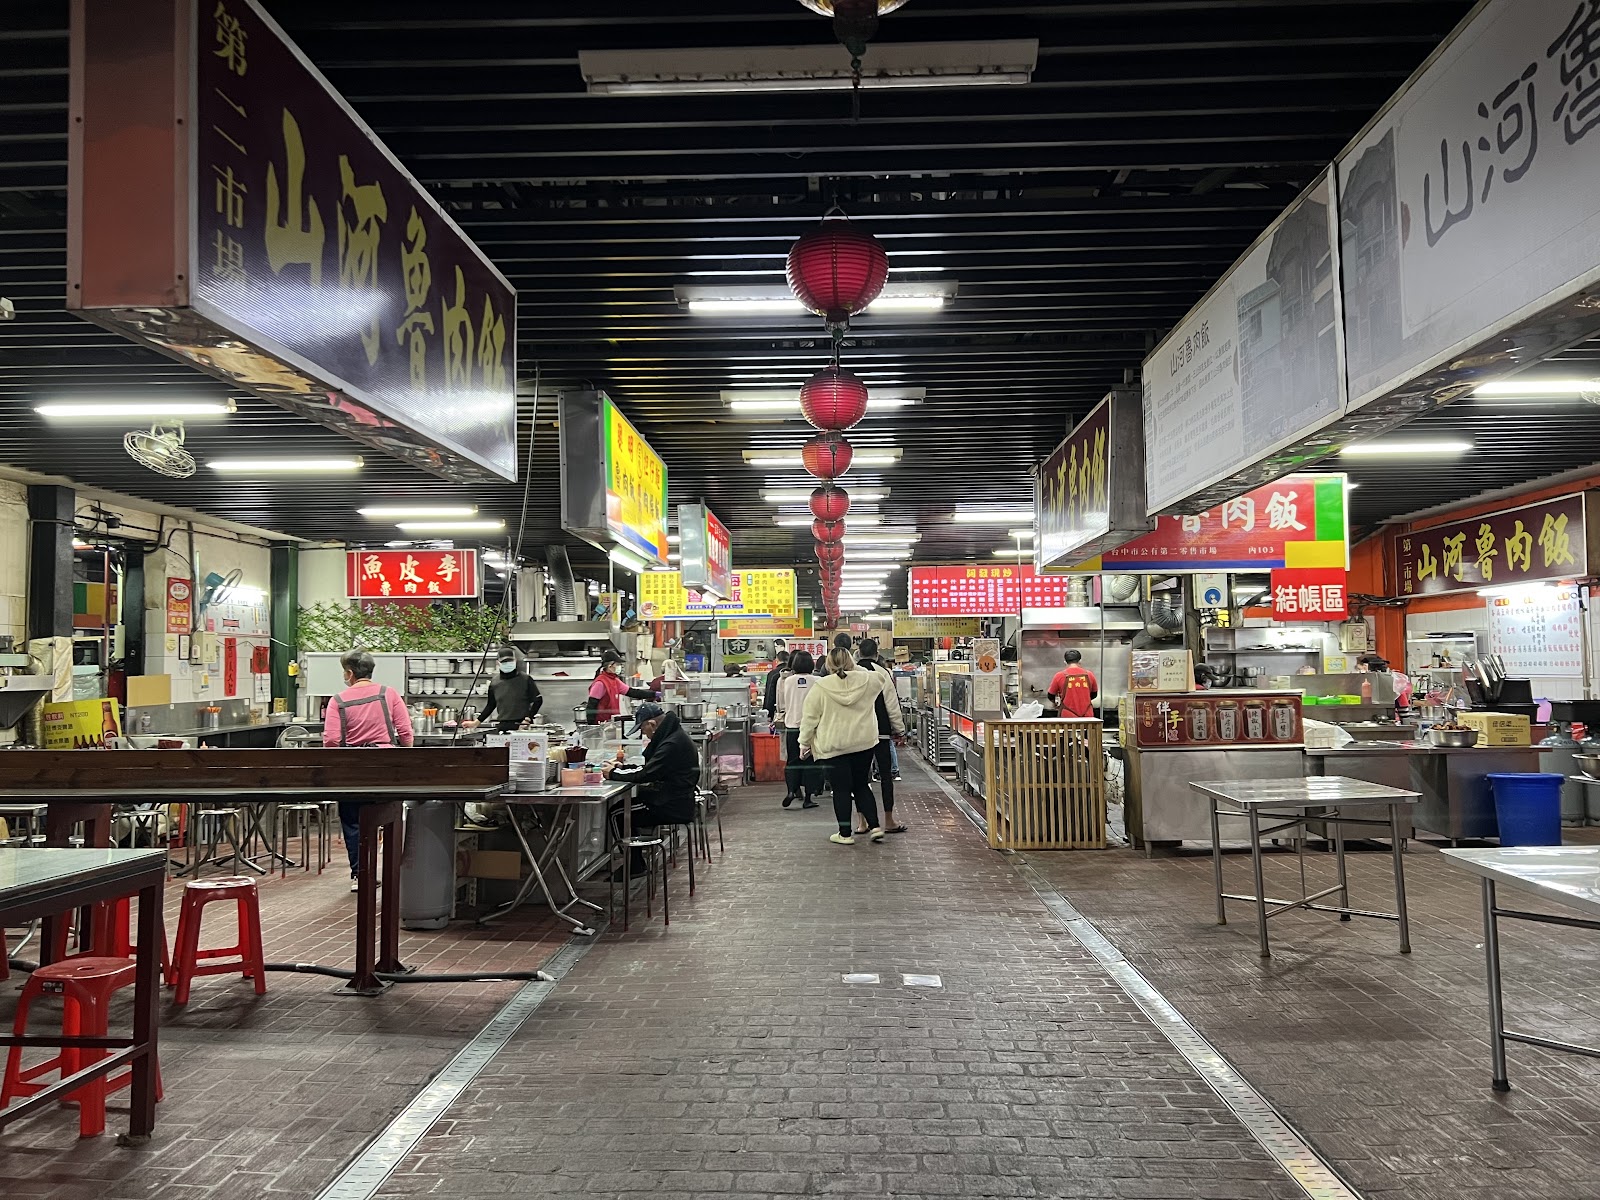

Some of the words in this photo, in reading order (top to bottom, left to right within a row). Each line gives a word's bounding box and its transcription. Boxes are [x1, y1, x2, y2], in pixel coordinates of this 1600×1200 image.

[211, 0, 249, 286] 第二市場
[265, 107, 509, 443] 山河魯肉飯
[1170, 320, 1210, 377] 山河魯肉飯
[1402, 538, 1413, 594] 第二市場
[1416, 512, 1575, 582] 山河魯肉飯
[380, 581, 443, 596] 魯肉飯
[1274, 584, 1345, 613] 結帳區
